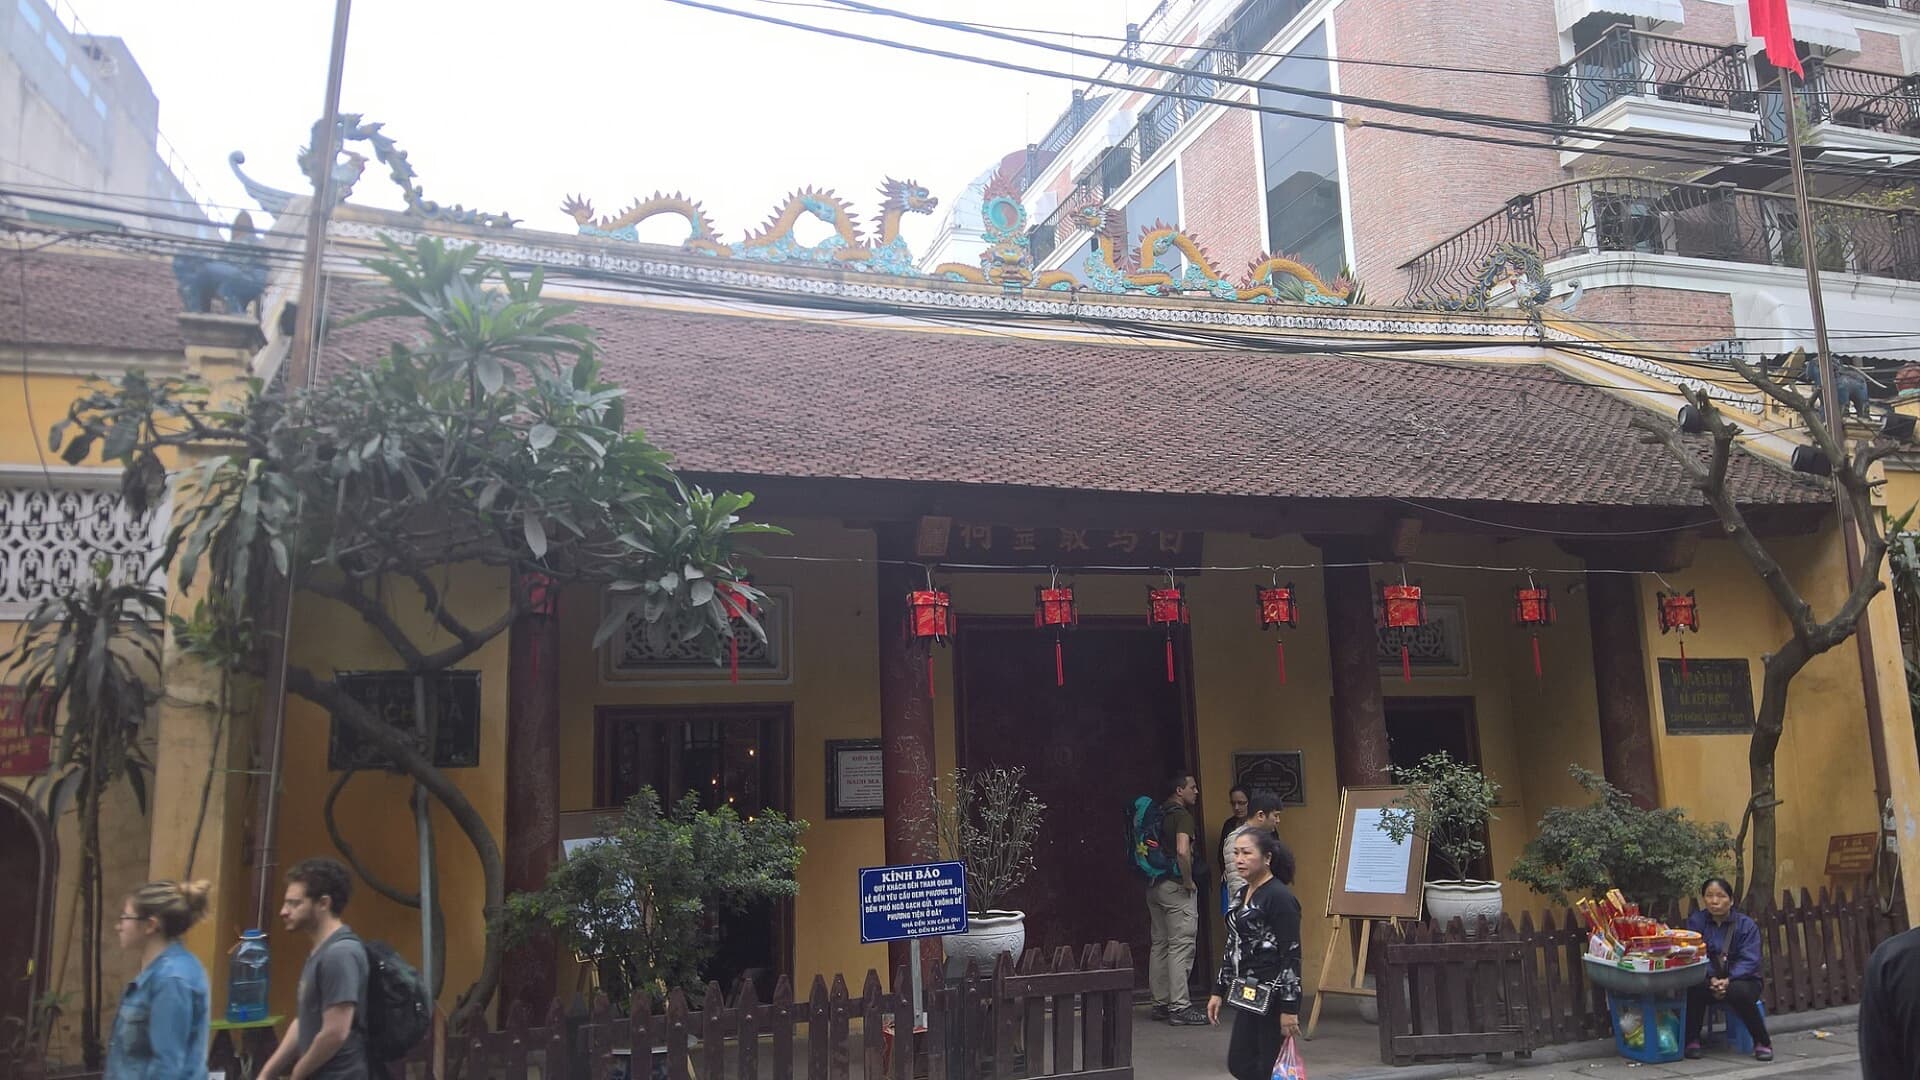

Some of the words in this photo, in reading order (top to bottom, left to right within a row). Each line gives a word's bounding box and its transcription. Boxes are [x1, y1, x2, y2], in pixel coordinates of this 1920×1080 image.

[882, 870, 913, 882] KÍNH
[915, 867, 940, 879] BÁO
[886, 882, 906, 891] KHÁCH
[919, 879, 936, 888] THAM
[937, 878, 952, 886] QUAN
[886, 892, 897, 901] YÊU
[879, 902, 891, 912] PHỐ
[905, 901, 921, 911] GẠCH
[935, 897, 953, 906] KHÔNG
[912, 910, 925, 919] TIỆN
[926, 908, 930, 917] Ở
[931, 908, 942, 916] ĐÂY
